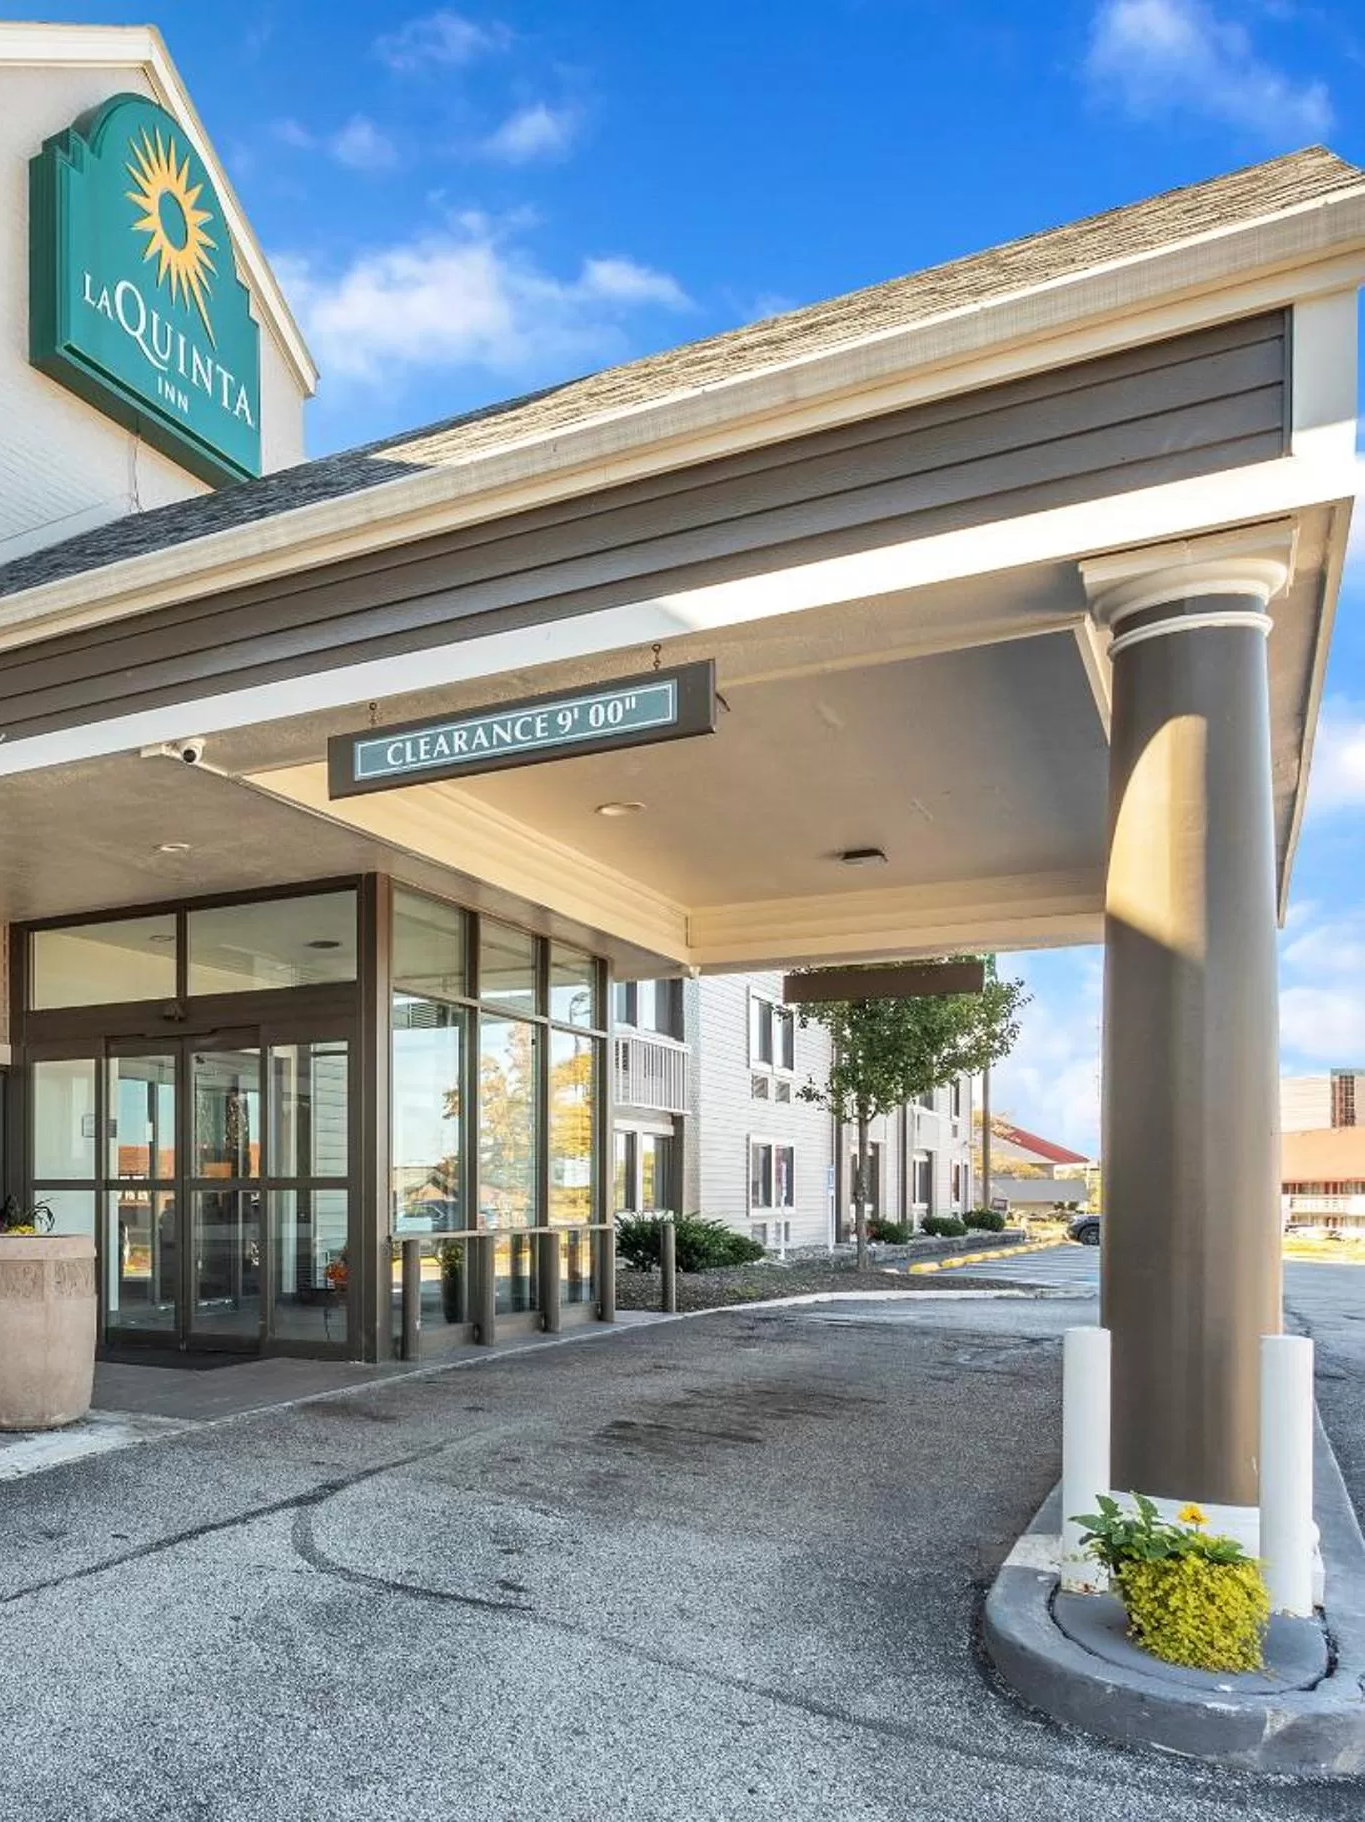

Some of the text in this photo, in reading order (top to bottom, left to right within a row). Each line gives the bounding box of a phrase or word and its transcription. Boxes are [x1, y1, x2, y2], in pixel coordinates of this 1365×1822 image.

[115, 280, 254, 426] QUINTA
[157, 376, 189, 414] INN
[386, 713, 548, 767] CLEARANCE
[556, 708, 580, 734] 9'
